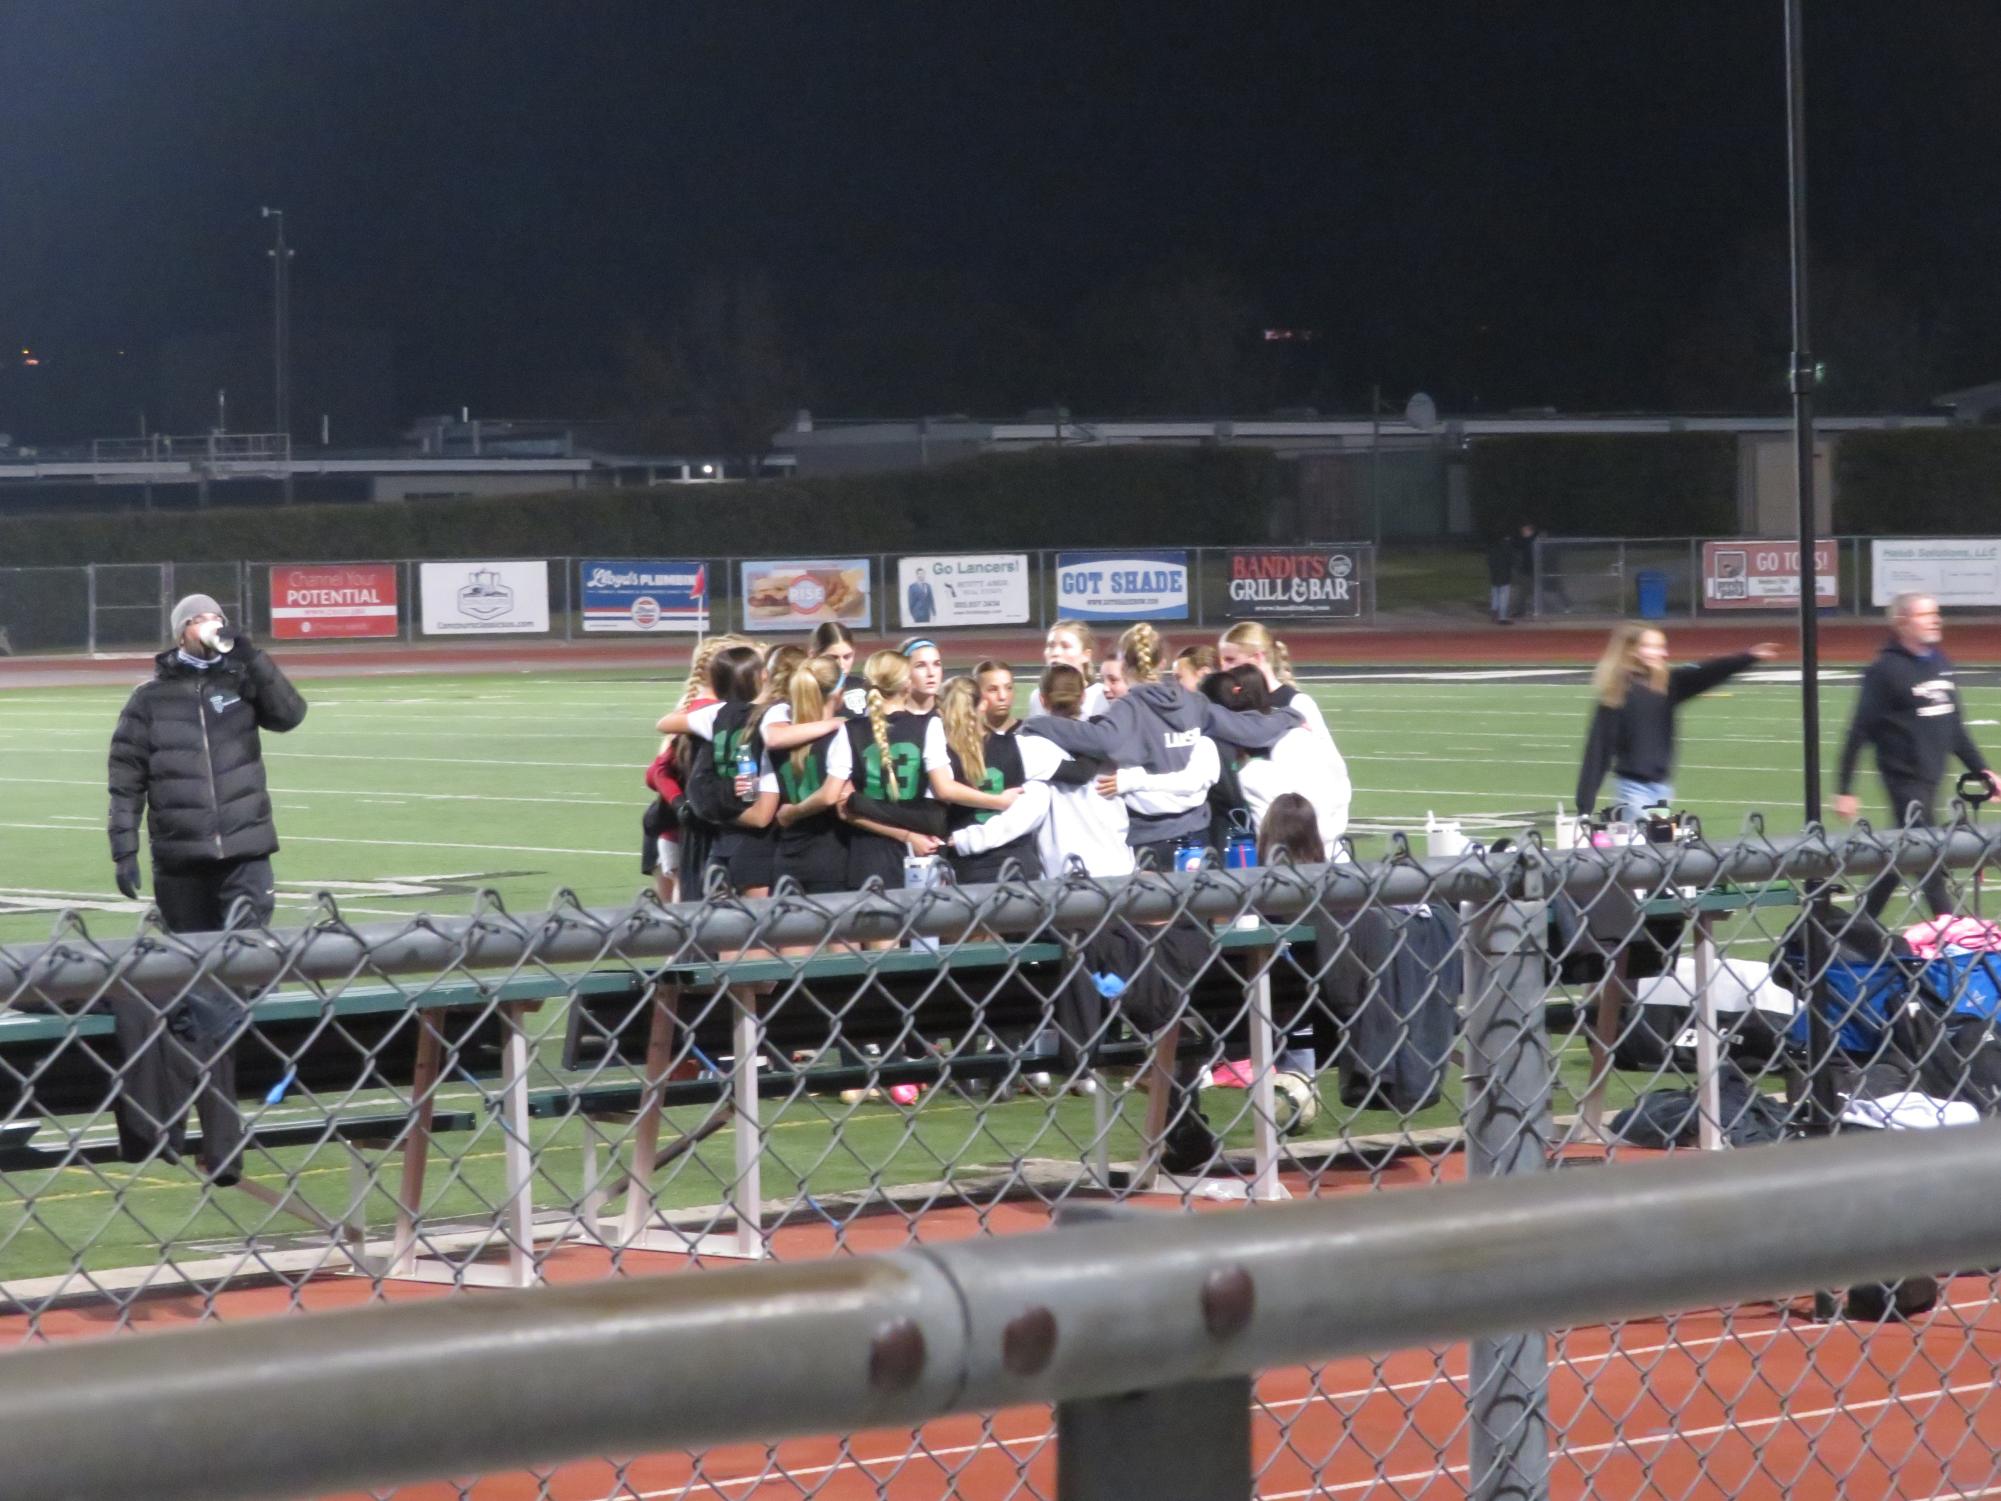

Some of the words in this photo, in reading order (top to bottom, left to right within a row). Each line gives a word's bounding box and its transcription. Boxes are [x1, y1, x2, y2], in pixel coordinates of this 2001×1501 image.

[932, 562, 953, 575] Go
[957, 559, 1019, 575] Lancers!
[1757, 552, 1778, 571] GO
[1784, 551, 1828, 570] TOS!
[289, 570, 343, 587] Channel
[345, 571, 376, 586] Your
[586, 567, 638, 588] Lloyd's
[1062, 572, 1103, 594] GOT
[1110, 571, 1183, 594] SHADE
[287, 588, 381, 605] POTENTIAL
[1308, 578, 1350, 600] BAR
[863, 741, 921, 802] 13
